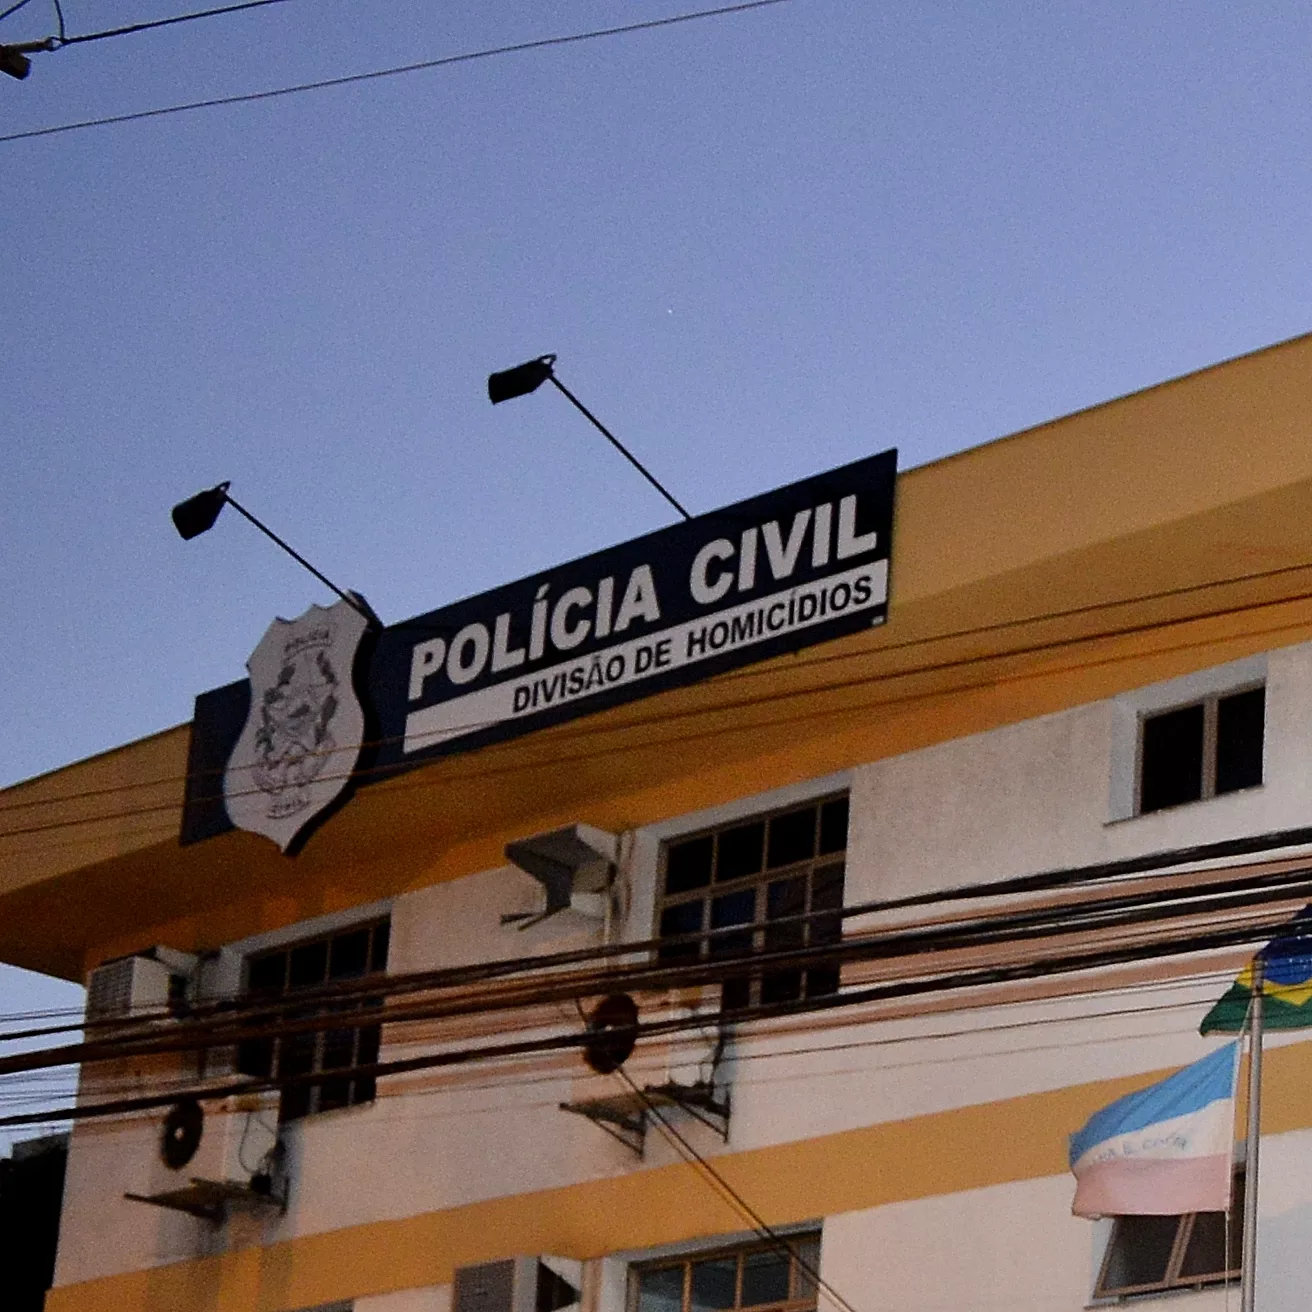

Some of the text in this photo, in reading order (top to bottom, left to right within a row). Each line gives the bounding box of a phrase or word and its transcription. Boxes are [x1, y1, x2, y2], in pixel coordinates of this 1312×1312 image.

[407, 494, 878, 701] POLÍCIA CIVIL
[512, 575, 873, 714] DIVISÃO DE HOMICÍDIOS
